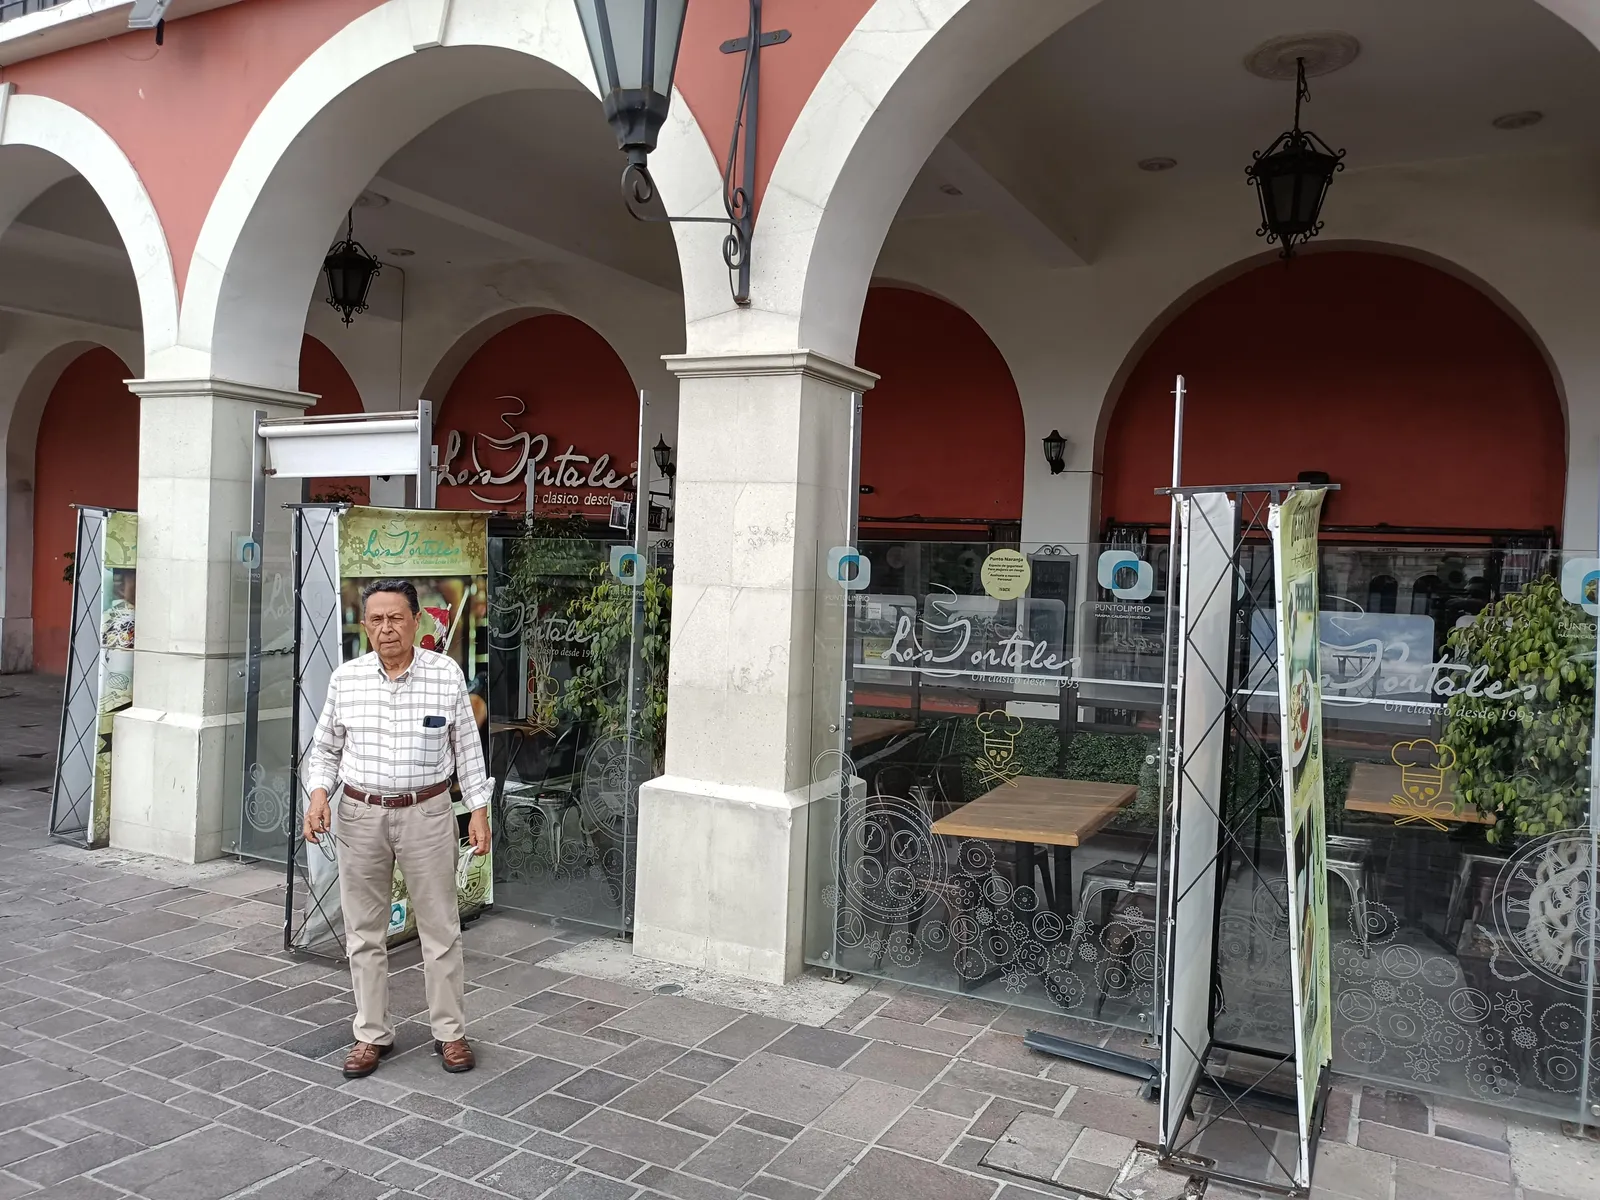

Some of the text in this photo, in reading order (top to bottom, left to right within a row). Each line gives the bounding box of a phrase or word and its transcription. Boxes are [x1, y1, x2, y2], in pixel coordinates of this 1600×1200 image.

[437, 430, 492, 486] Los
[584, 492, 617, 506] desde
[363, 529, 461, 557] Los Portales
[1094, 603, 1151, 613] PUNTOLIMPIO
[881, 615, 934, 663] Los
[1320, 638, 1537, 700] Portales
[1054, 679, 1080, 689] 1993
[1384, 701, 1403, 713] Un
[1456, 705, 1495, 720] desde
[1500, 708, 1535, 723] 1993
